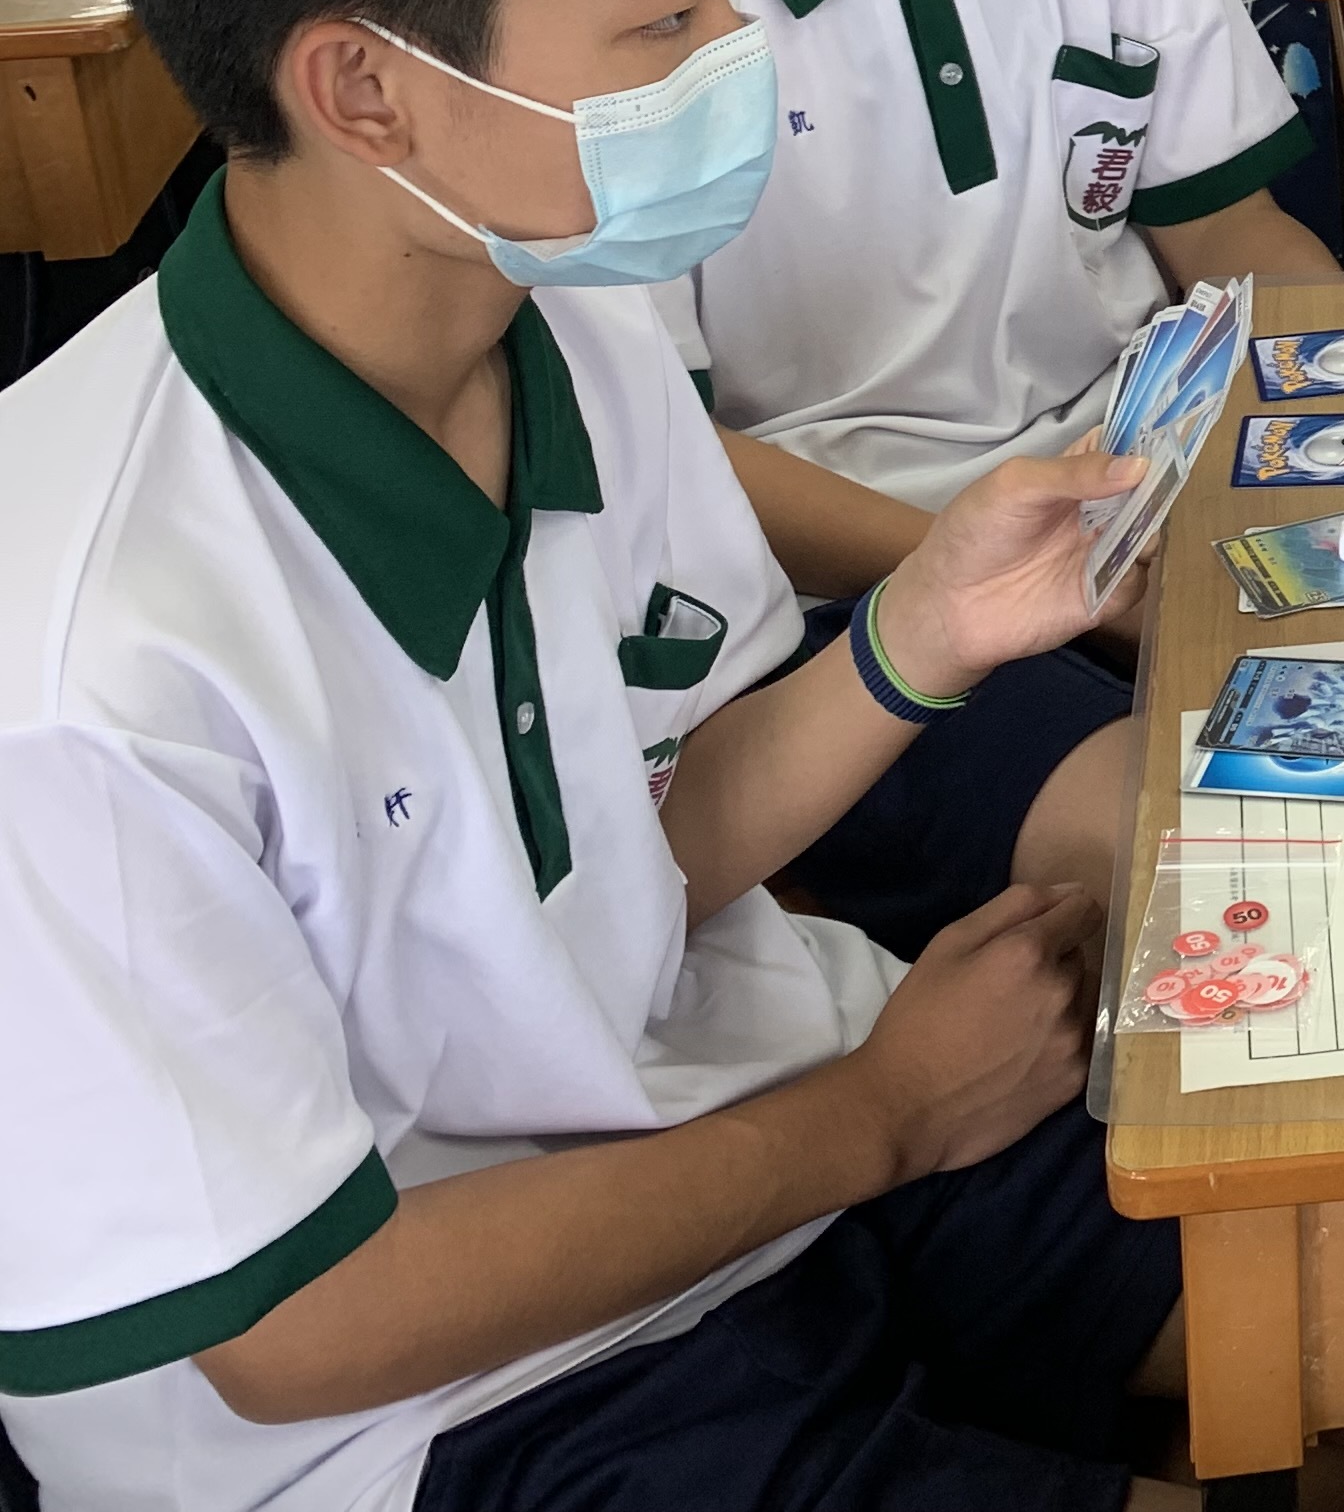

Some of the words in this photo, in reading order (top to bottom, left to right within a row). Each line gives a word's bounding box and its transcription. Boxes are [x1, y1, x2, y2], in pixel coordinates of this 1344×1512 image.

[1083, 148, 1134, 213] 君毅
[1232, 908, 1262, 925] 50
[1185, 934, 1211, 951] 50
[1220, 956, 1240, 966] 10
[1158, 982, 1176, 992] 10
[1200, 985, 1233, 1003] 50
